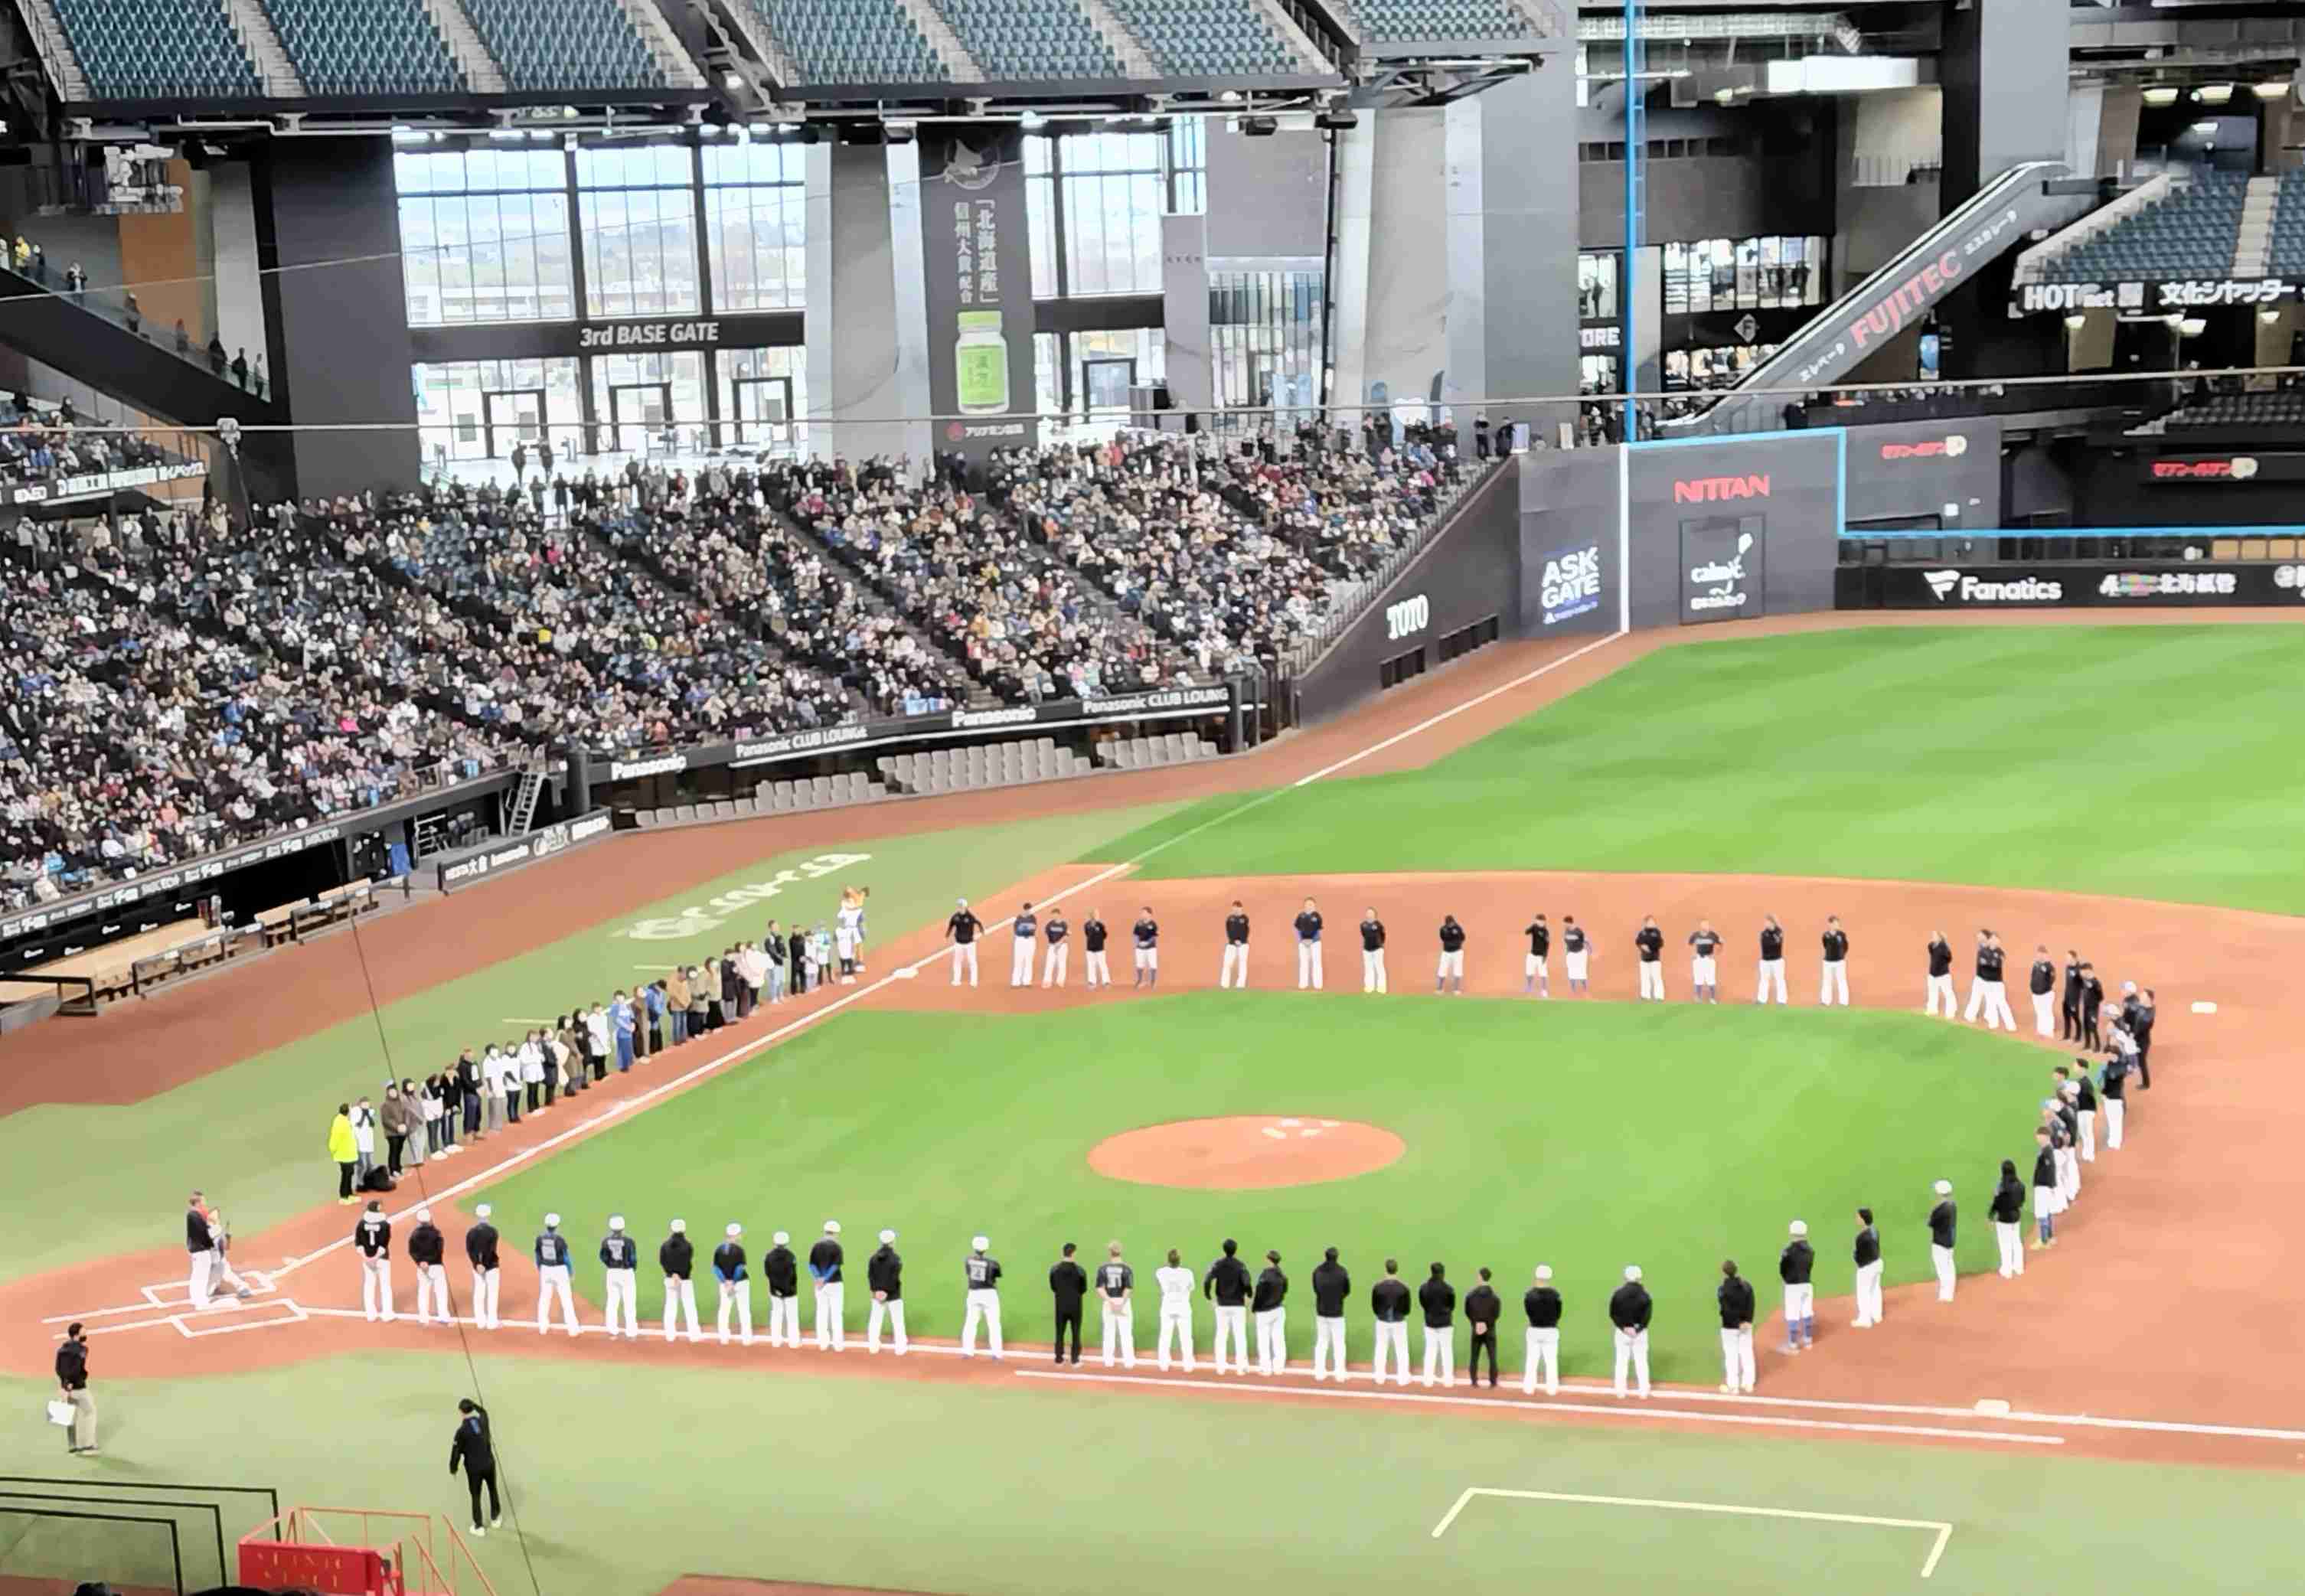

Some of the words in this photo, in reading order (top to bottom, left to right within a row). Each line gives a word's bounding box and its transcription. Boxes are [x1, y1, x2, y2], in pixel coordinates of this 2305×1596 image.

[1849, 250, 1962, 348] FUJITEC
[2159, 279, 2296, 307] 文化シャッター
[580, 325, 613, 347] 3rd
[616, 325, 667, 344] BASE
[670, 322, 720, 343] GATE
[1579, 327, 1621, 348] ORE
[1673, 473, 1771, 503] NITTAN
[1542, 547, 1599, 587] ASK
[1541, 573, 1601, 609] GATE
[1961, 576, 2062, 601] Fanatics
[1386, 593, 1429, 640] TOTO
[952, 703, 1036, 727] Panasonic
[1082, 696, 1148, 714] Panasonic
[1148, 692, 1182, 707] CLUB
[1184, 688, 1229, 703] LOUNG
[735, 736, 791, 758] Panasonic
[792, 732, 822, 749] CLUB
[611, 752, 687, 781] Panasonic
